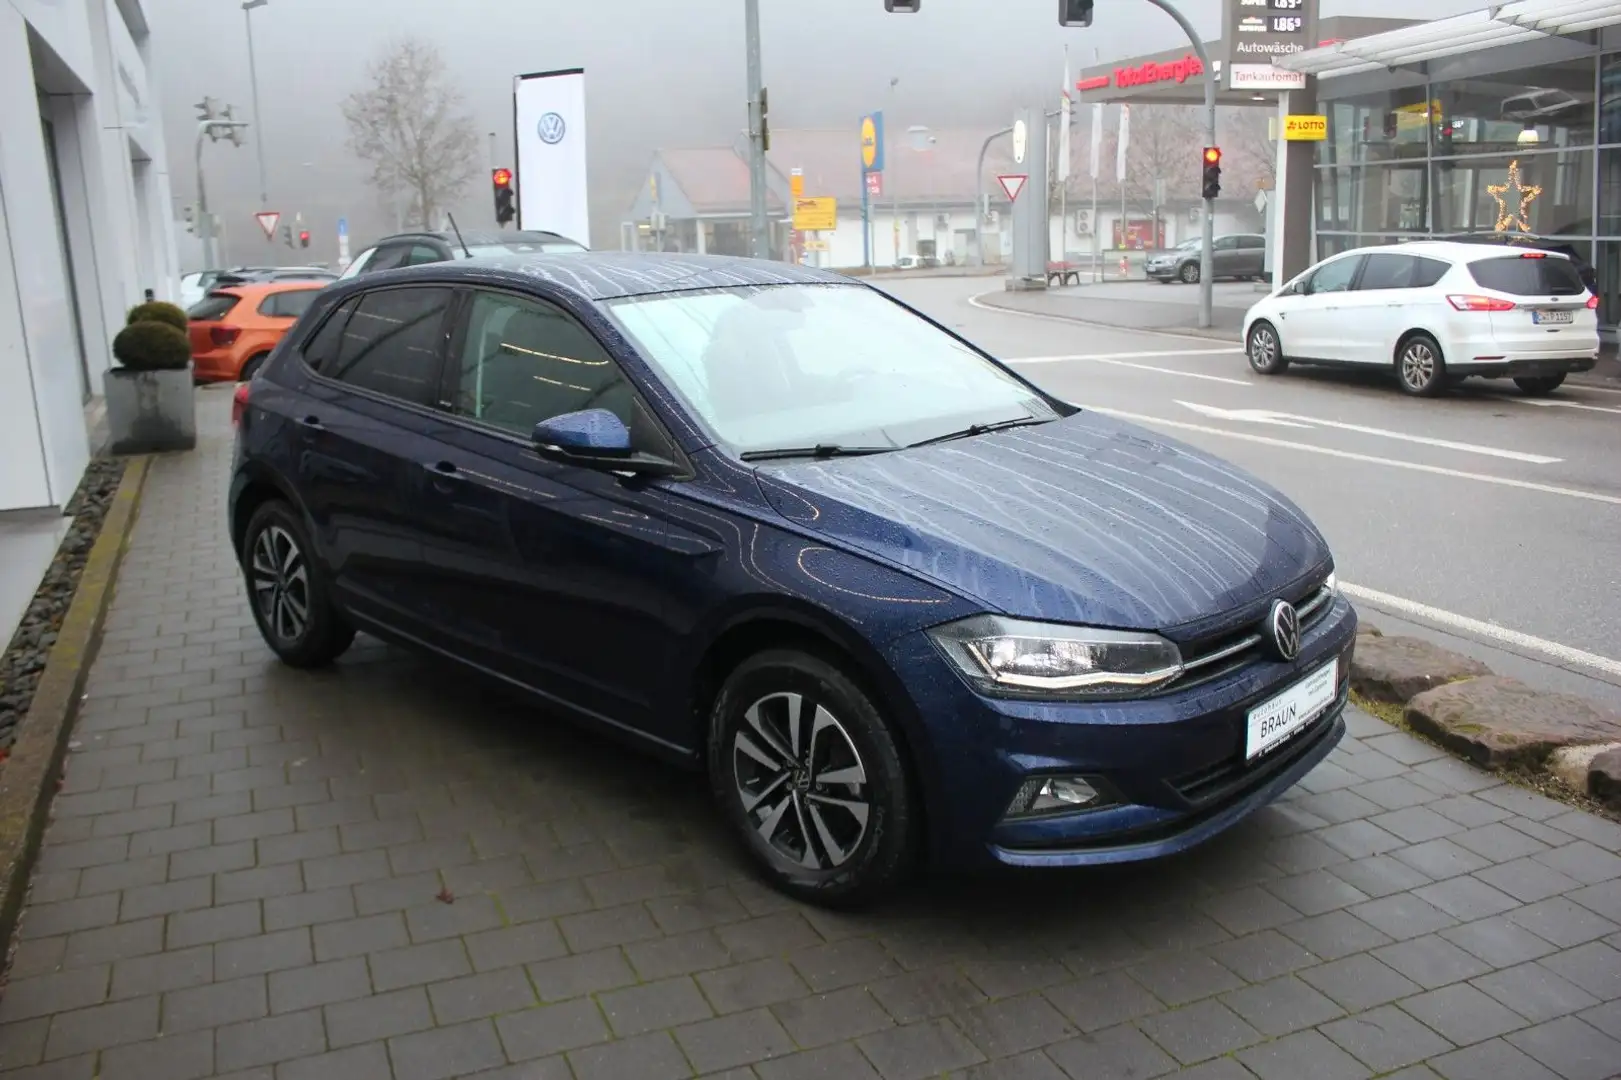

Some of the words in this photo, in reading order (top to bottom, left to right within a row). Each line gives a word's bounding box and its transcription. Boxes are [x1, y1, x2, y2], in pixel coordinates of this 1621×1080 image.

[1237, 42, 1304, 53] Autowäsche
[1235, 72, 1304, 82] Tankautomat
[1298, 121, 1325, 130] LOTTO
[1260, 702, 1297, 739] BRAUN
